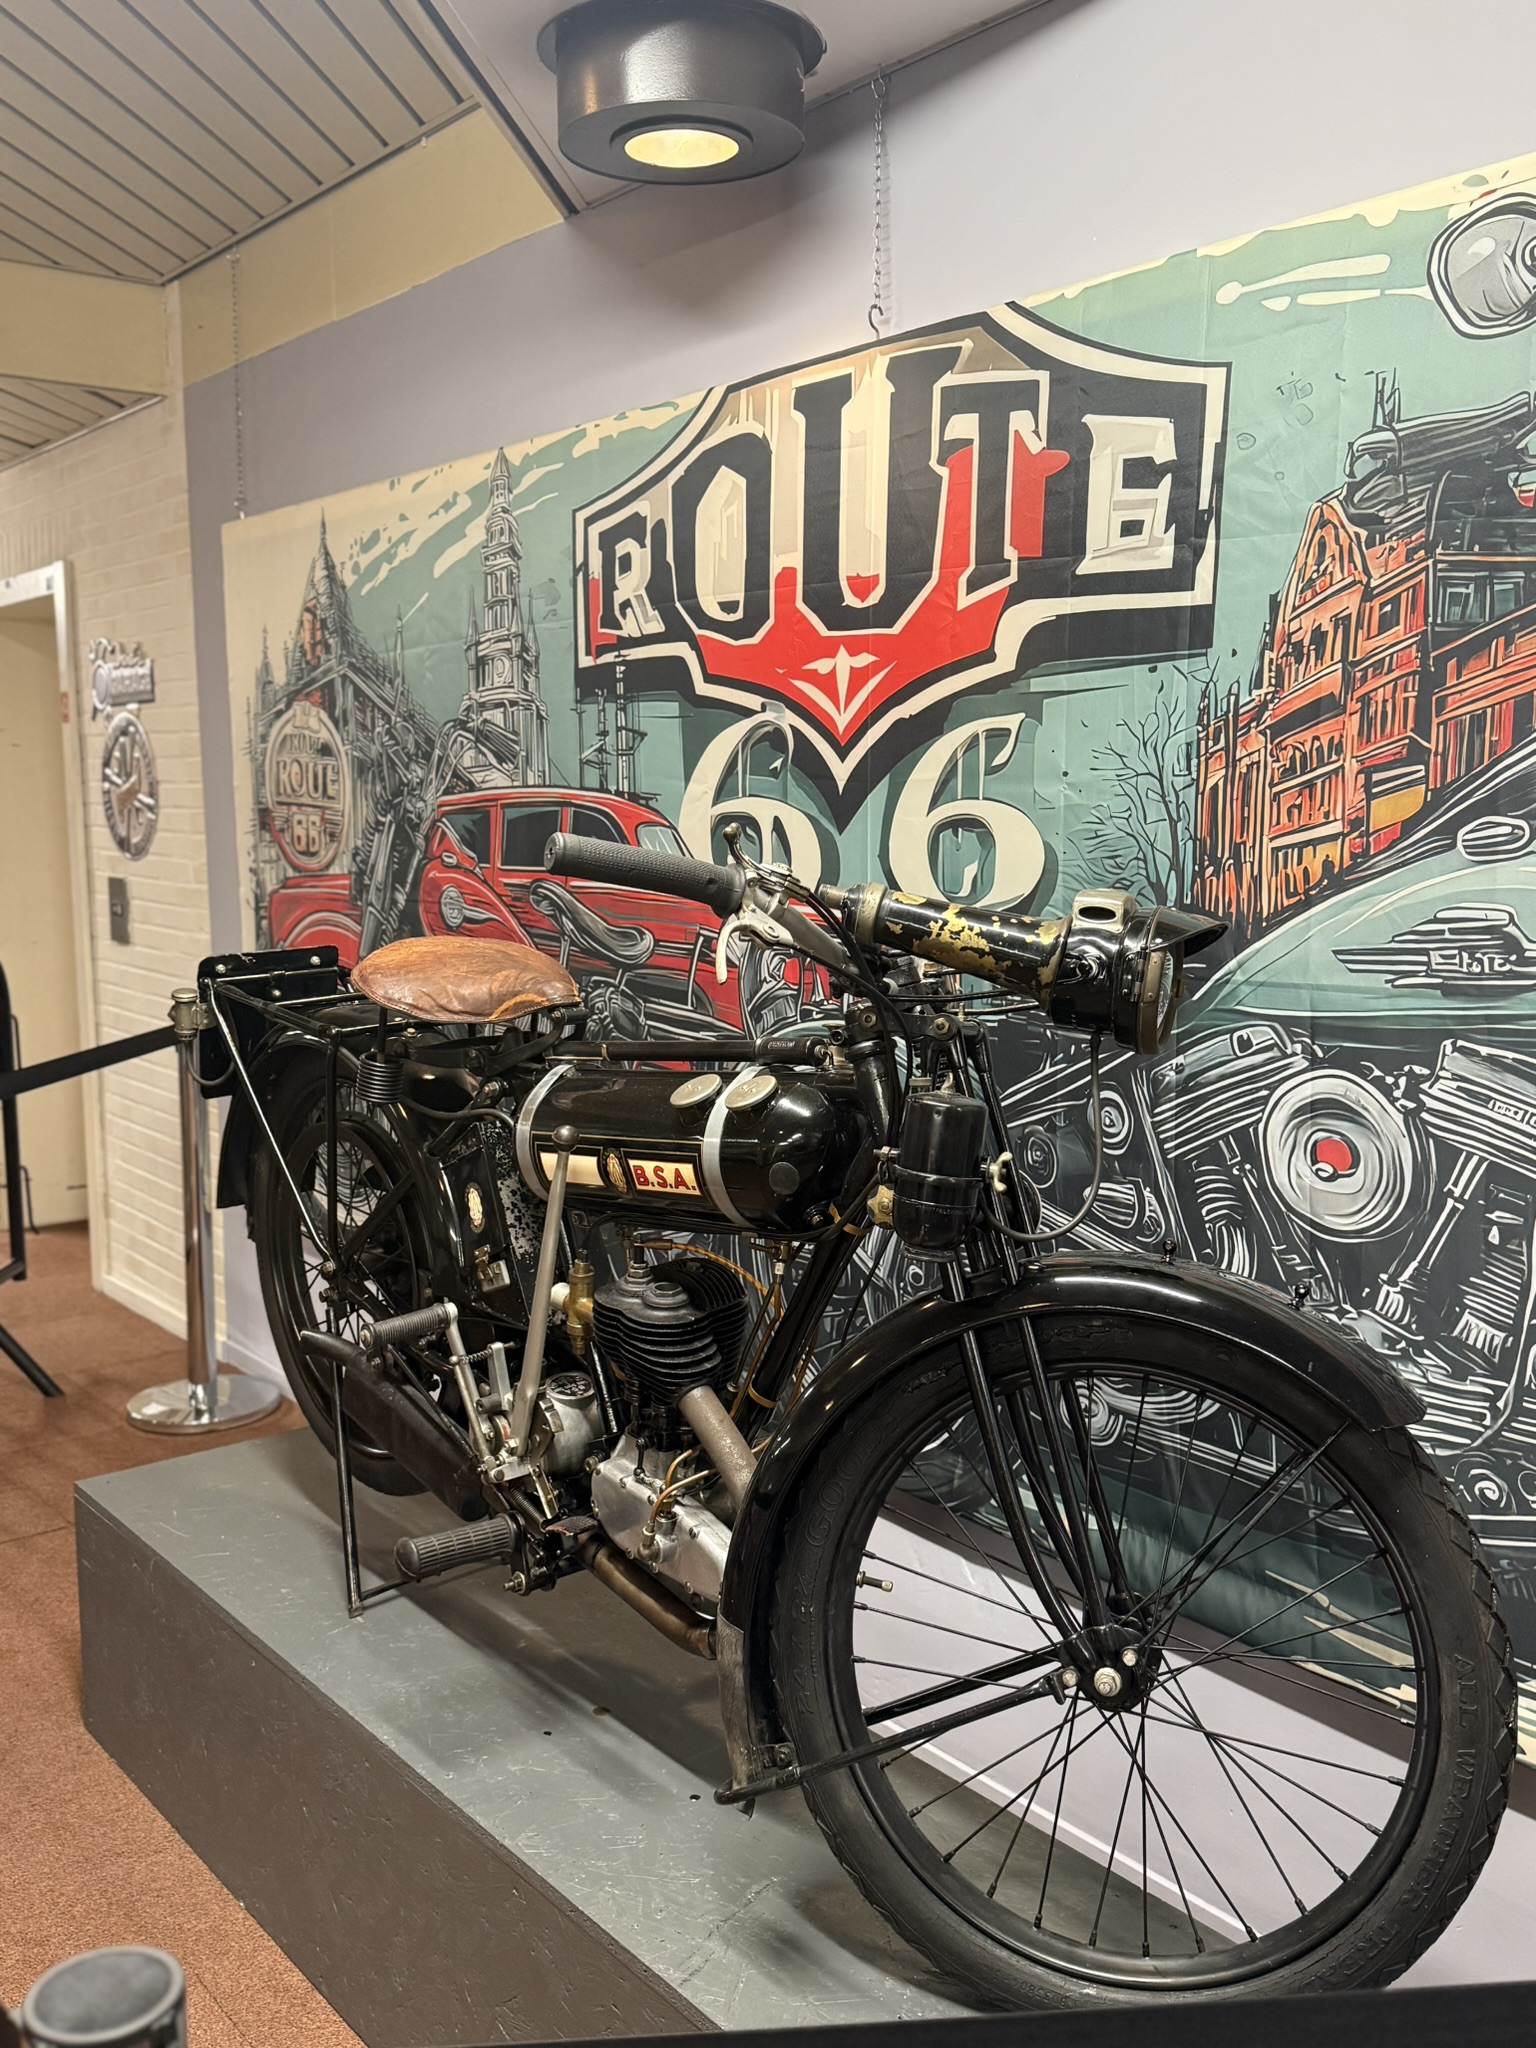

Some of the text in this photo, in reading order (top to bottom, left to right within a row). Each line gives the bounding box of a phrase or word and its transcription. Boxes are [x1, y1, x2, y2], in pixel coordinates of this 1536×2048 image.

[592, 342, 1178, 646] ROUTE
[293, 813, 321, 853] 66
[678, 702, 1046, 912] 66
[632, 1164, 697, 1191] B.S.A.
[1453, 1652, 1480, 1729] ALL
[1400, 1748, 1477, 1913] WEATHER
